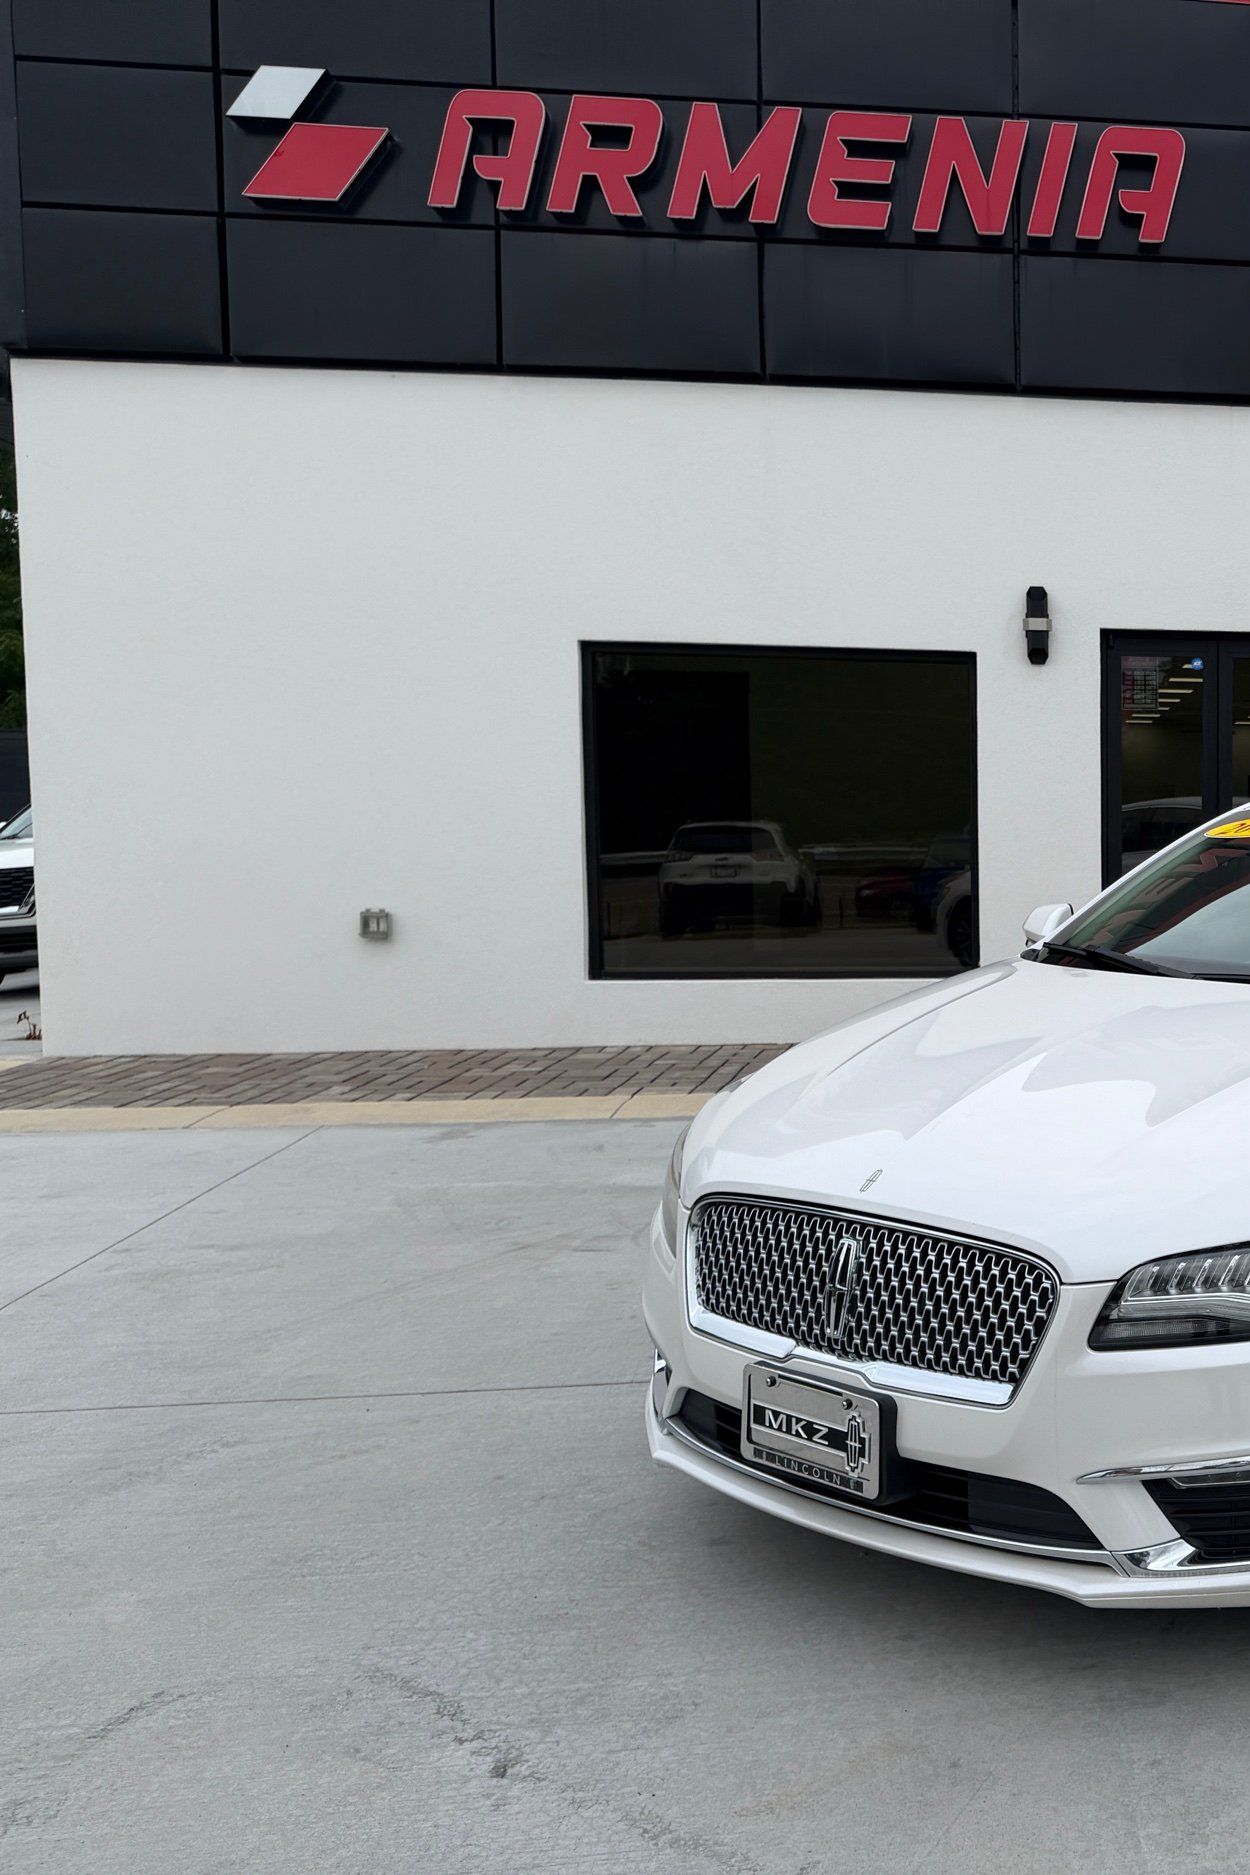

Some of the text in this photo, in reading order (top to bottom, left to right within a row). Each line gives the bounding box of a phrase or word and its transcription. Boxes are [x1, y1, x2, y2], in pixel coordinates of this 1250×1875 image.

[428, 88, 1187, 243] ARMENIA
[764, 1409, 830, 1446] MKZ
[775, 1454, 841, 1486] LINCOLN
